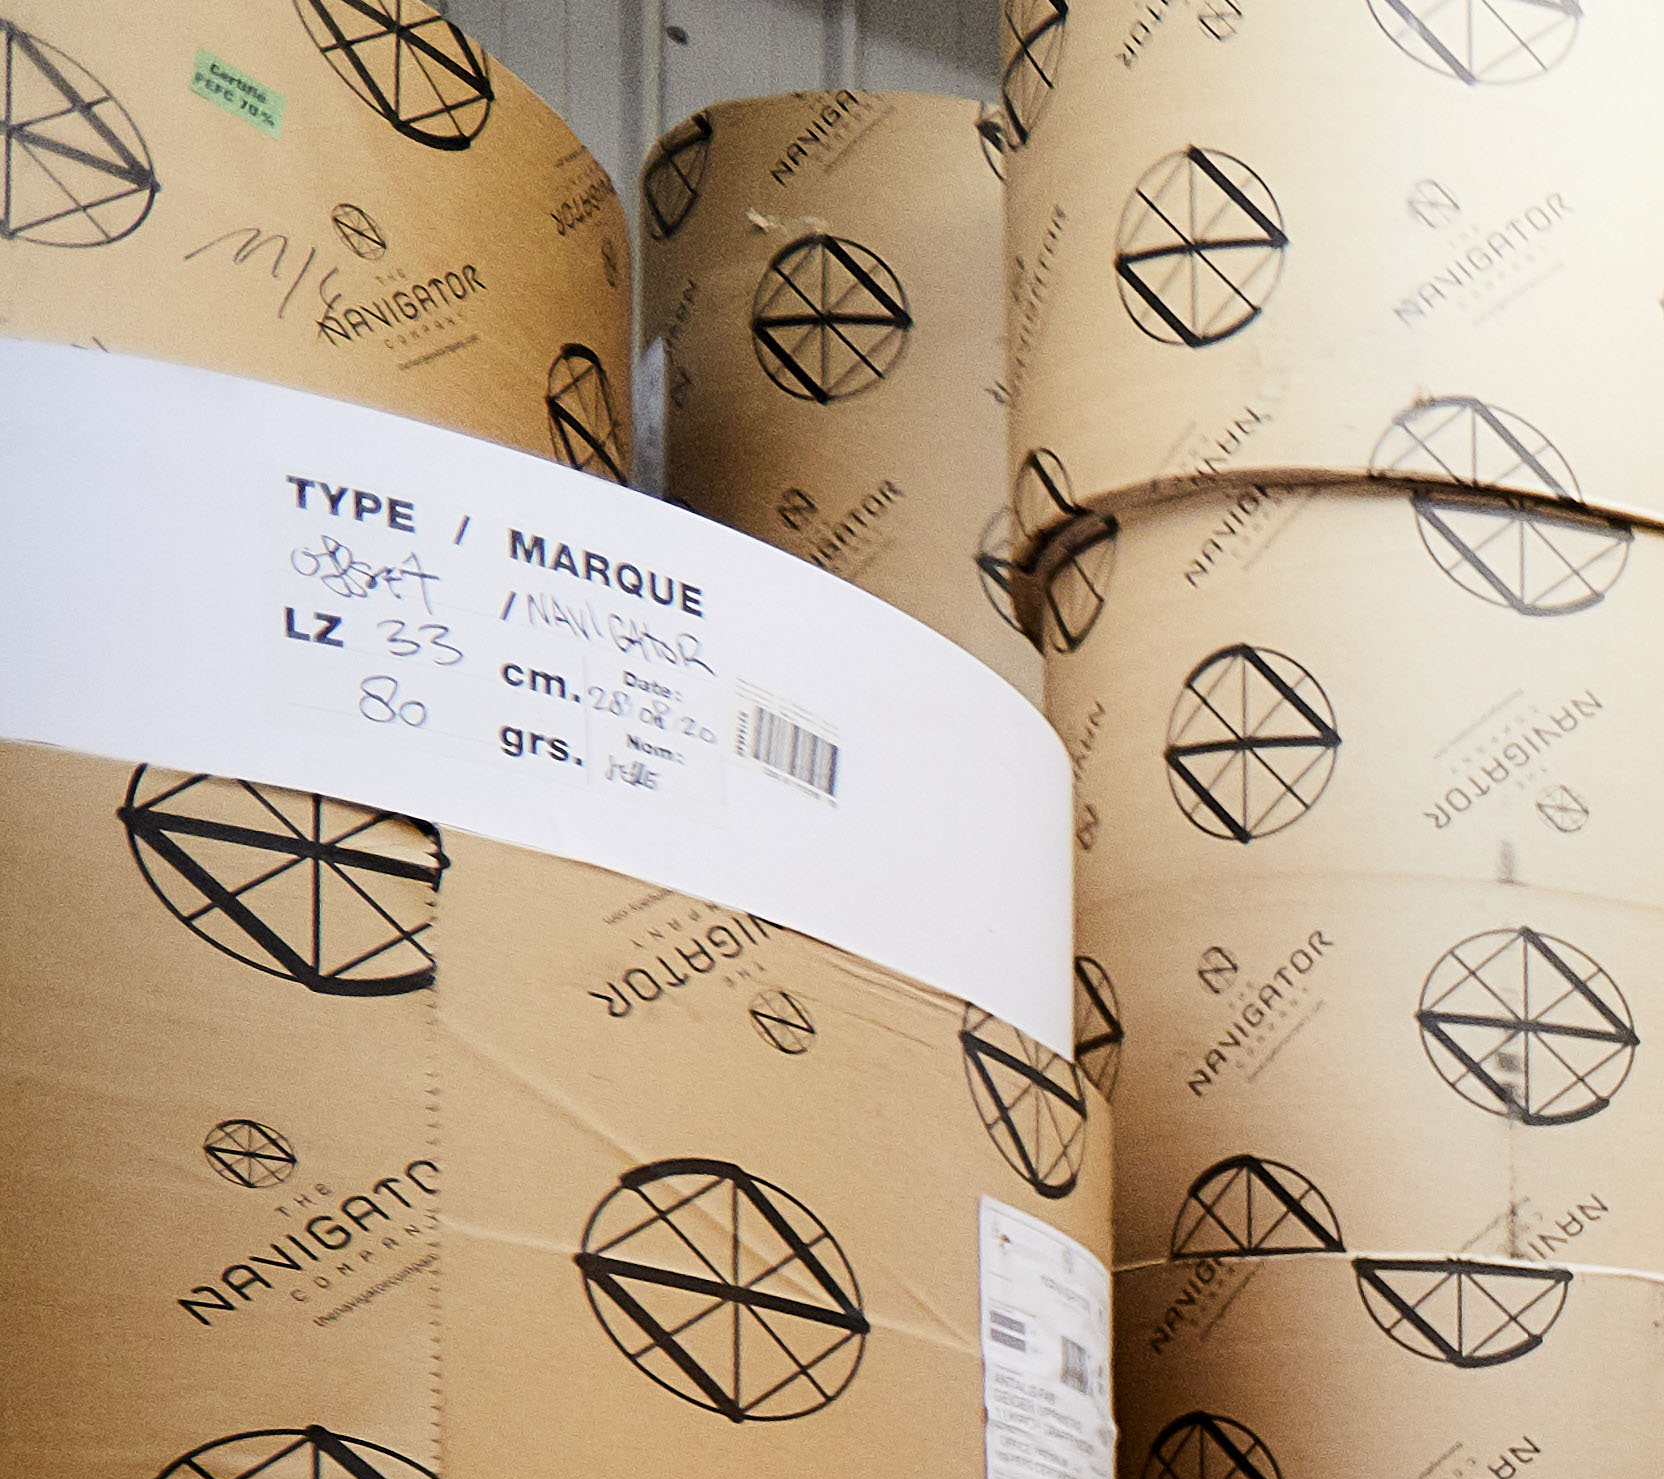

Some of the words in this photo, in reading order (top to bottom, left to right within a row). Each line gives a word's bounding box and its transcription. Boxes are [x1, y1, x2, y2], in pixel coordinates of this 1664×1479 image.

[317, 265, 487, 346] NAVIGATOR
[1395, 190, 1574, 328] NAVIGATOR
[287, 475, 415, 533] TYPE
[508, 528, 705, 619] MARQUE
[285, 607, 345, 648] LZ
[377, 620, 463, 666] 33
[502, 662, 581, 704] cm.
[622, 671, 683, 702] Date:
[359, 675, 426, 727] 80
[499, 724, 585, 766] grs.
[626, 732, 686, 766] Nom:
[1423, 689, 1603, 831] NAVIGATOR
[1188, 928, 1335, 1096] NAVIGATOR
[178, 1160, 441, 1325] NAVIGATO
[277, 1182, 332, 1218] THE
